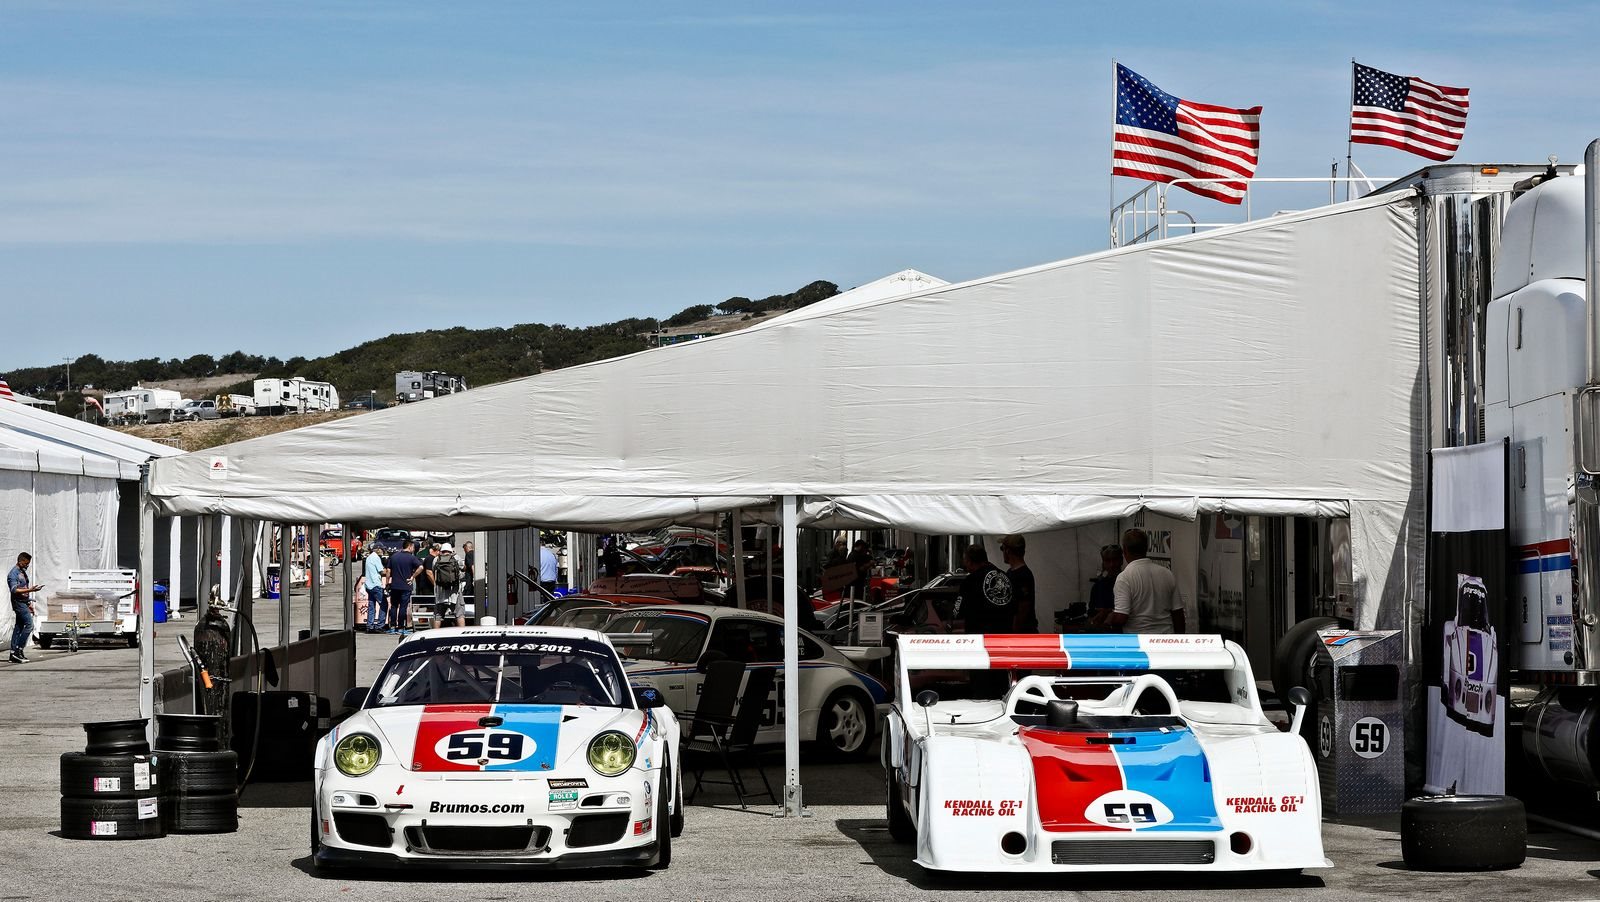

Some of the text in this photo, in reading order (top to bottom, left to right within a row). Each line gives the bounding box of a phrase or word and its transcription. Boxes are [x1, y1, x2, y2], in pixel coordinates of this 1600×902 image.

[450, 643, 497, 653] ROLEX
[498, 643, 519, 651] 24
[538, 644, 573, 654] 2012
[1355, 723, 1385, 753] 59
[446, 733, 524, 760] 59
[944, 800, 1023, 809] KENDALL GT-1
[1226, 796, 1304, 806] KENDALL GT-1
[429, 801, 525, 813] Brumos.com
[952, 808, 1016, 816] RACING OIL
[1235, 804, 1298, 813] RACING OIL
[1103, 803, 1158, 823] 59
